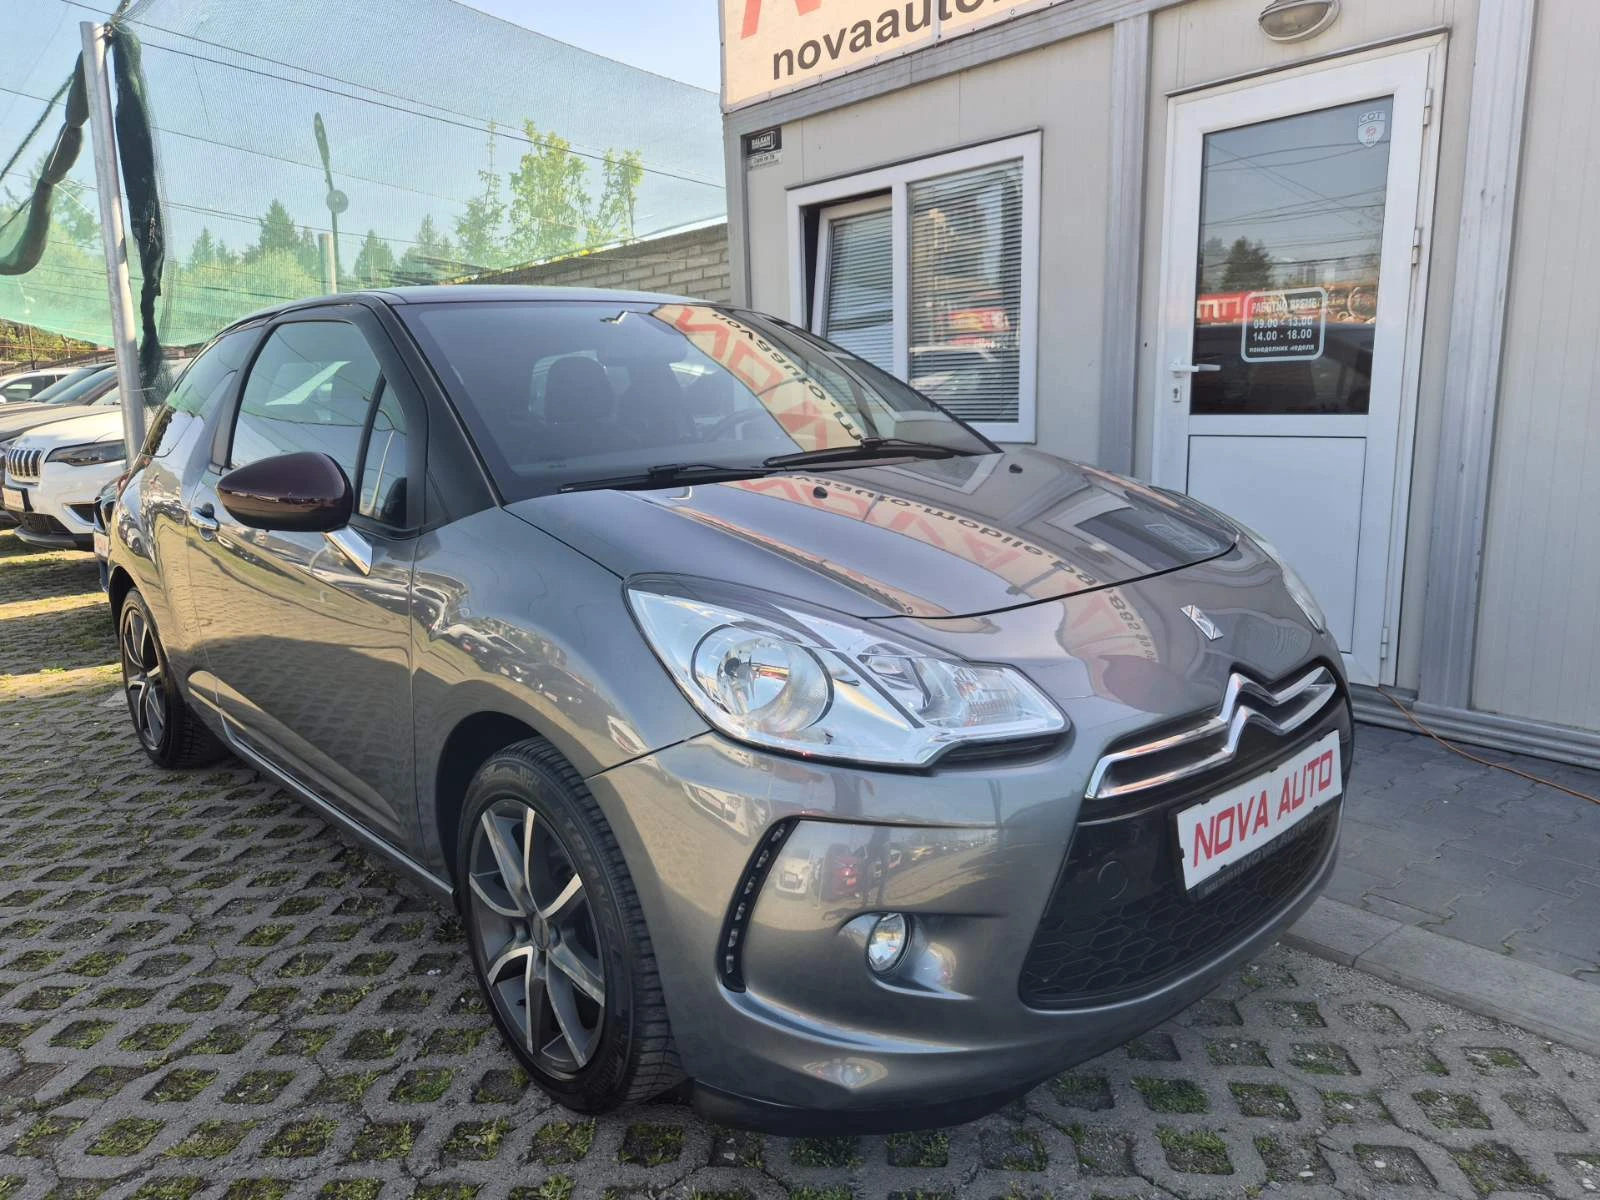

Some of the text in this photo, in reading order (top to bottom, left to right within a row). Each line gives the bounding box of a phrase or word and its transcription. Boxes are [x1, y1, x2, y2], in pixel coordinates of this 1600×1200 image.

[1253, 319, 1278, 329] 09.00
[1288, 316, 1313, 327] 13.00
[1253, 331, 1277, 342] 14.00
[1287, 329, 1312, 340] 18.00
[1193, 790, 1269, 868] NOVA
[1277, 749, 1333, 820] AUTO
